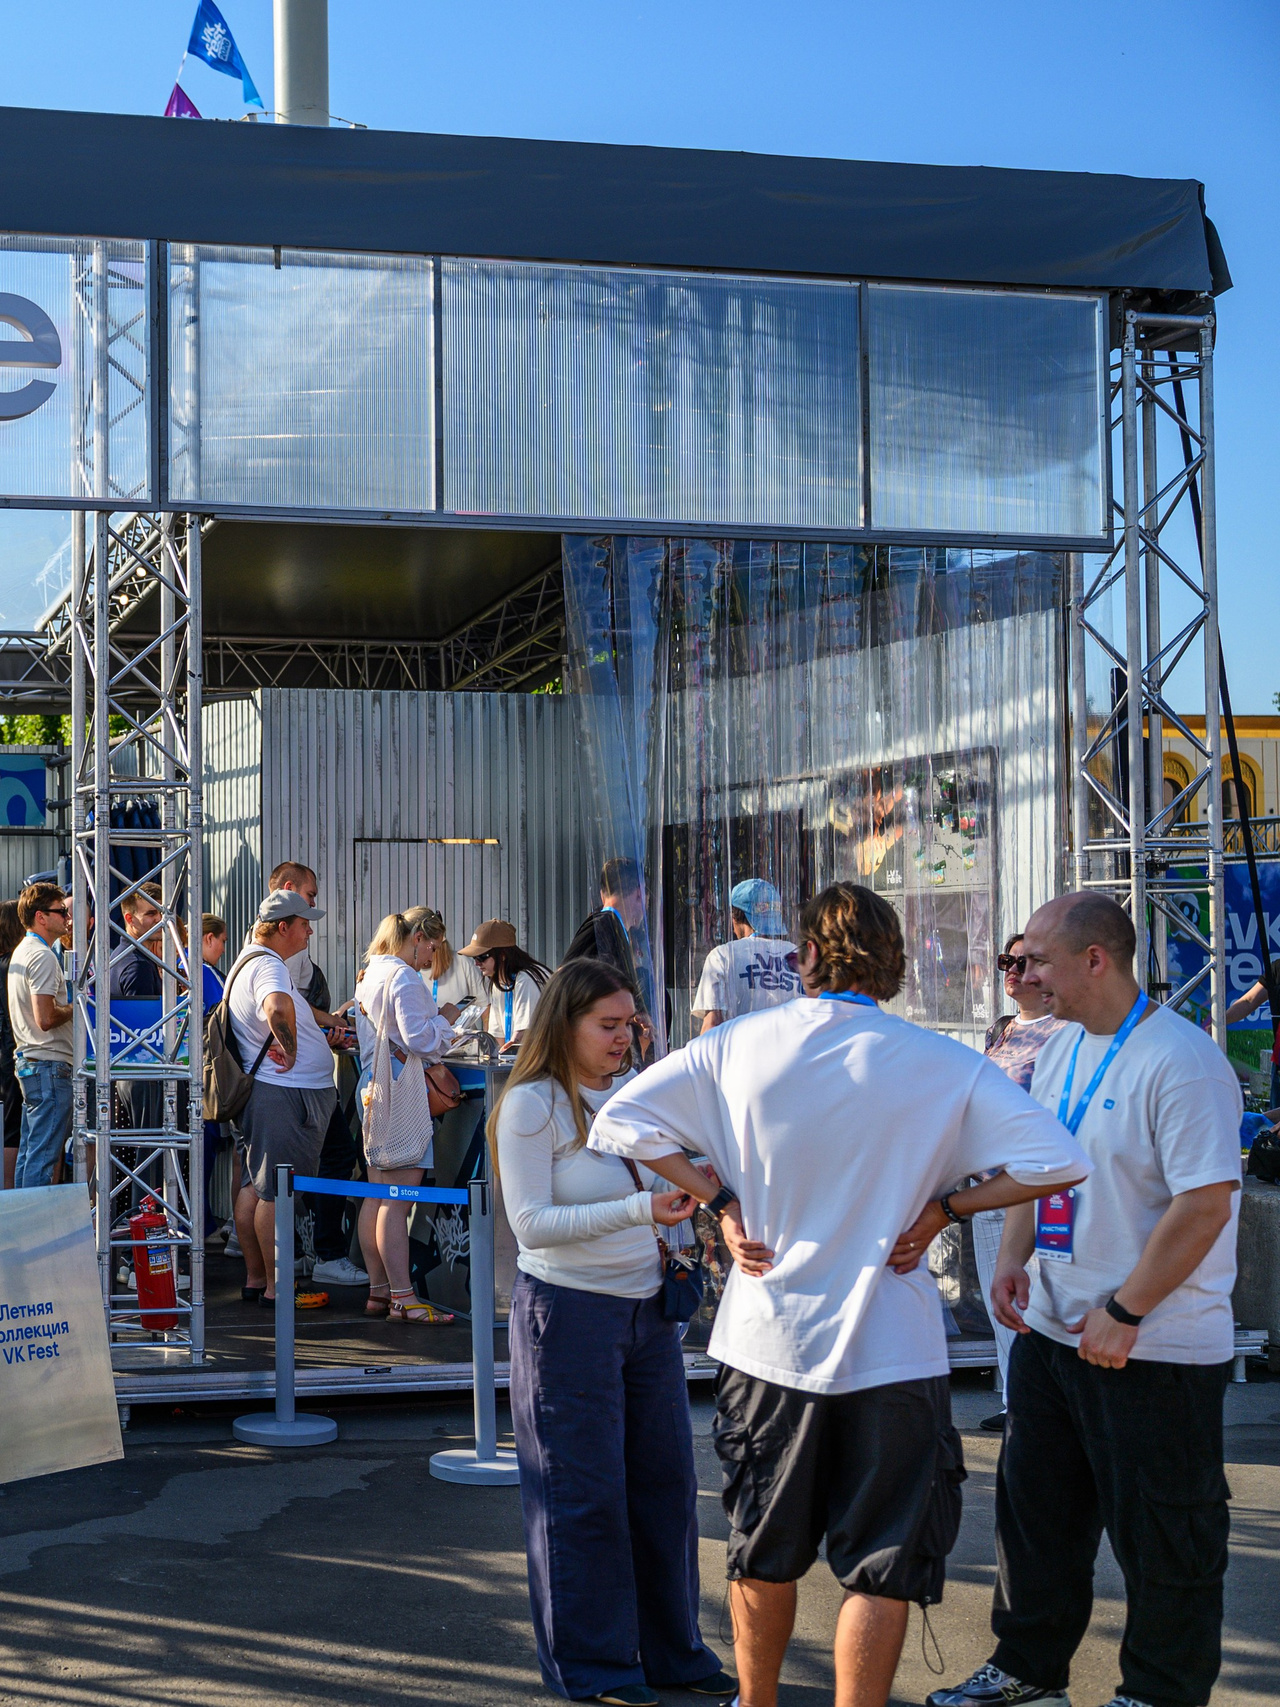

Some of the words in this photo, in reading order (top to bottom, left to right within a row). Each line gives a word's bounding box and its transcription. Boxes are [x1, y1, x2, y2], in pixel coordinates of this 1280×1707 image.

[400, 1188, 419, 1197] store
[0, 1302, 54, 1321] Летняя
[2, 1345, 26, 1365] VK
[27, 1341, 60, 1361] Fest
